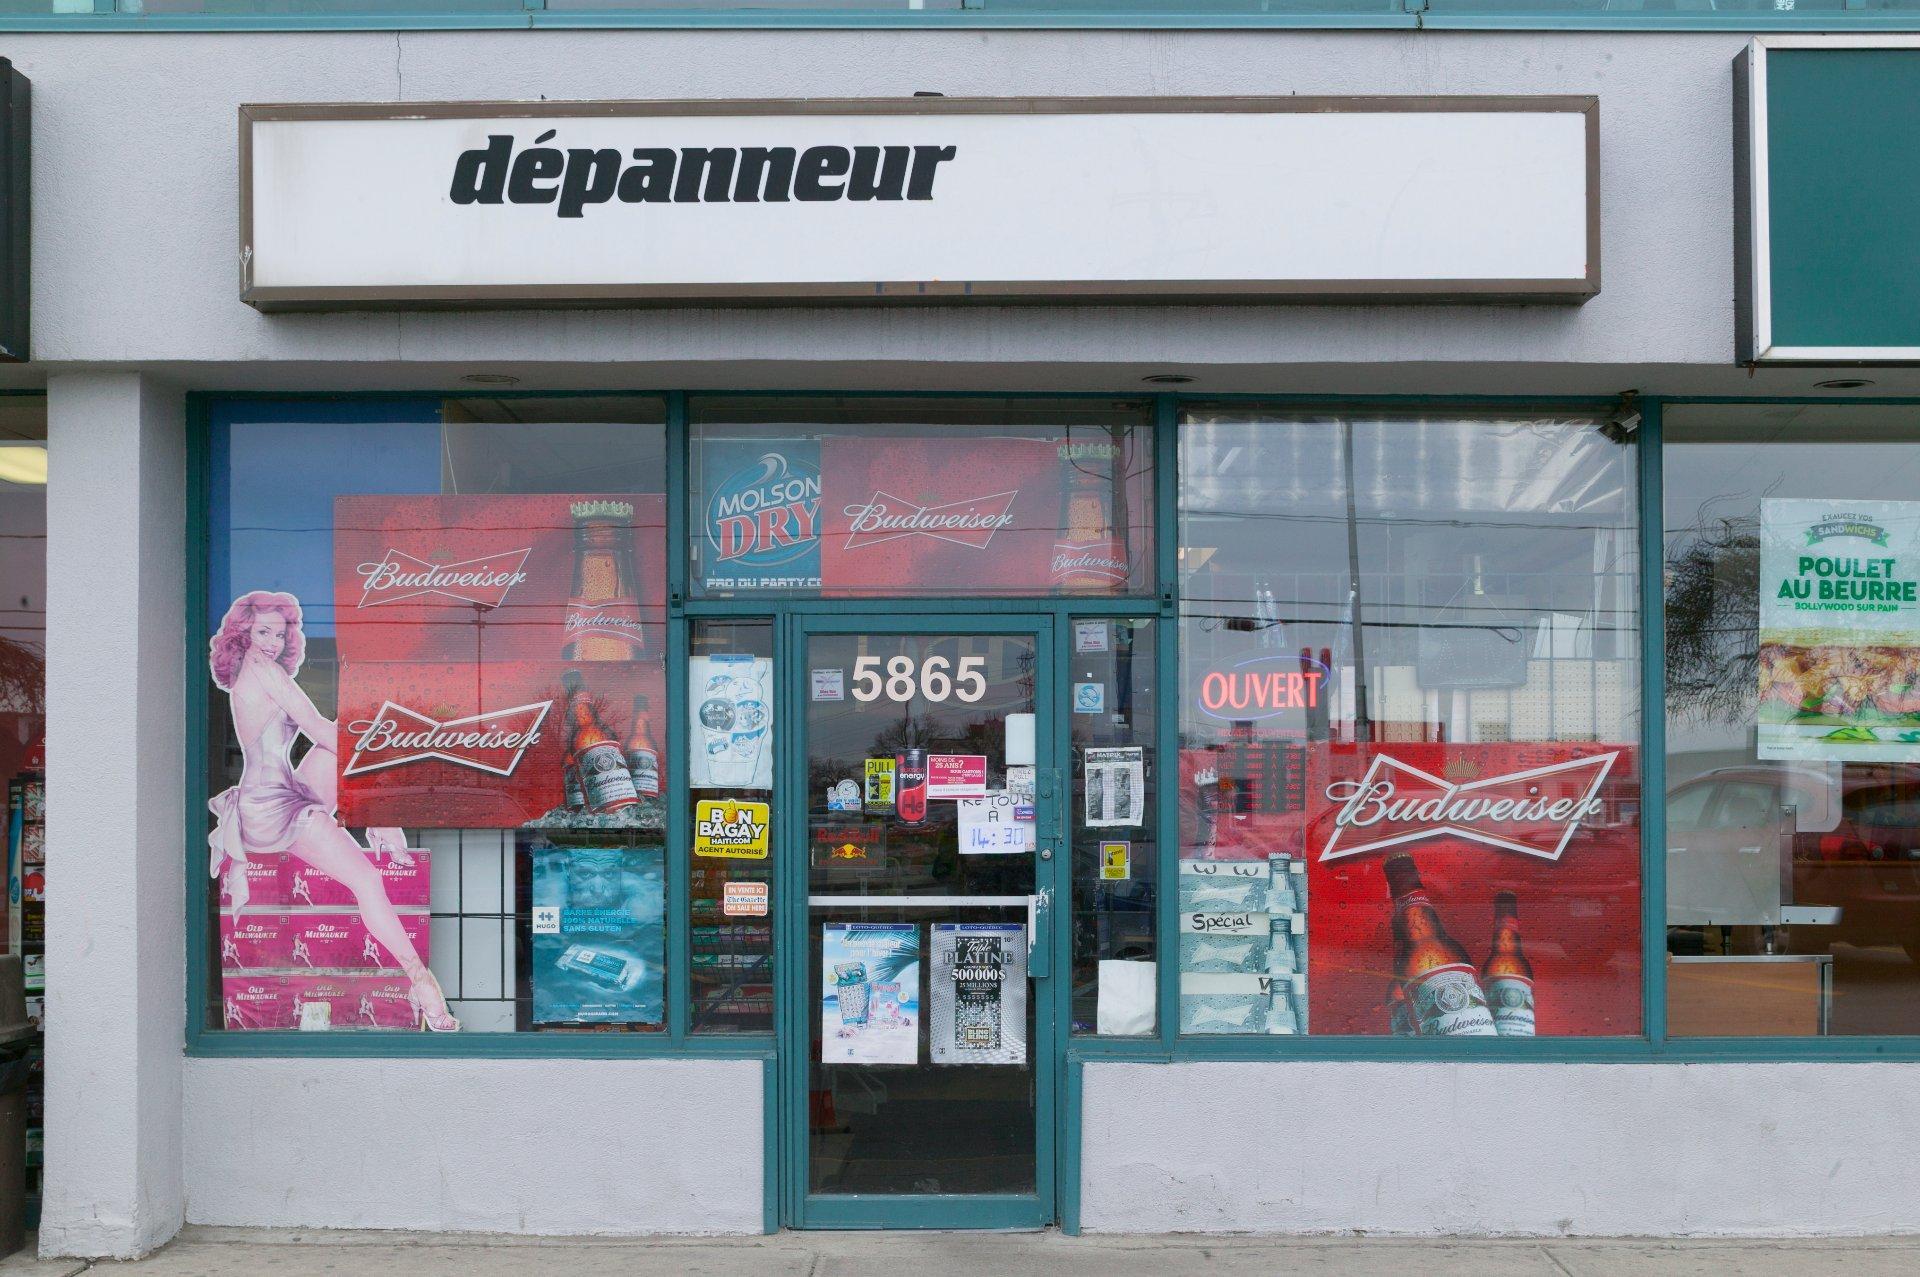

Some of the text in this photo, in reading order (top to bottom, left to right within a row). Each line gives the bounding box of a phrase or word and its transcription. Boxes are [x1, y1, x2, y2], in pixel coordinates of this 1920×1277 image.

[450, 129, 957, 218] dépanneur
[718, 475, 822, 517] MOLSON
[844, 503, 1013, 532] Budweiser
[1822, 513, 1873, 522] EXAUCEZ VOS
[716, 497, 822, 561] DRY
[1818, 525, 1877, 536] SANDWICHS
[1799, 556, 1896, 579] POULET
[357, 562, 526, 590] Budweiser
[707, 578, 734, 588] PRO
[738, 578, 756, 587] DU
[1777, 578, 1917, 601] AU BEURRE
[1795, 602, 1899, 613] BOLLYWOOD SUR PAIN
[851, 655, 986, 703] 5865
[1203, 671, 1321, 710] OUVERT
[348, 719, 541, 752] Budweiser
[867, 762, 892, 774] PULL
[1325, 779, 1603, 827] Budweiser
[699, 821, 766, 839] BAGAY
[698, 846, 763, 855] AGENT AUTORISÉ
[246, 862, 263, 870] OLD
[737, 887, 755, 895] VENTE
[740, 896, 766, 904] Gazette
[737, 904, 751, 912] SALE
[751, 904, 766, 912] HERE
[1192, 912, 1253, 932] Spécial
[246, 924, 263, 932] OLD
[317, 924, 335, 932] OLD
[233, 931, 278, 940] MILWAUKEE
[304, 930, 349, 939] MILWAUKEE
[967, 940, 992, 956] Triple
[944, 951, 1014, 965] PLATINE
[248, 985, 265, 994] OLD
[384, 984, 401, 992] OLD
[235, 992, 278, 1001] MILWAUKEE
